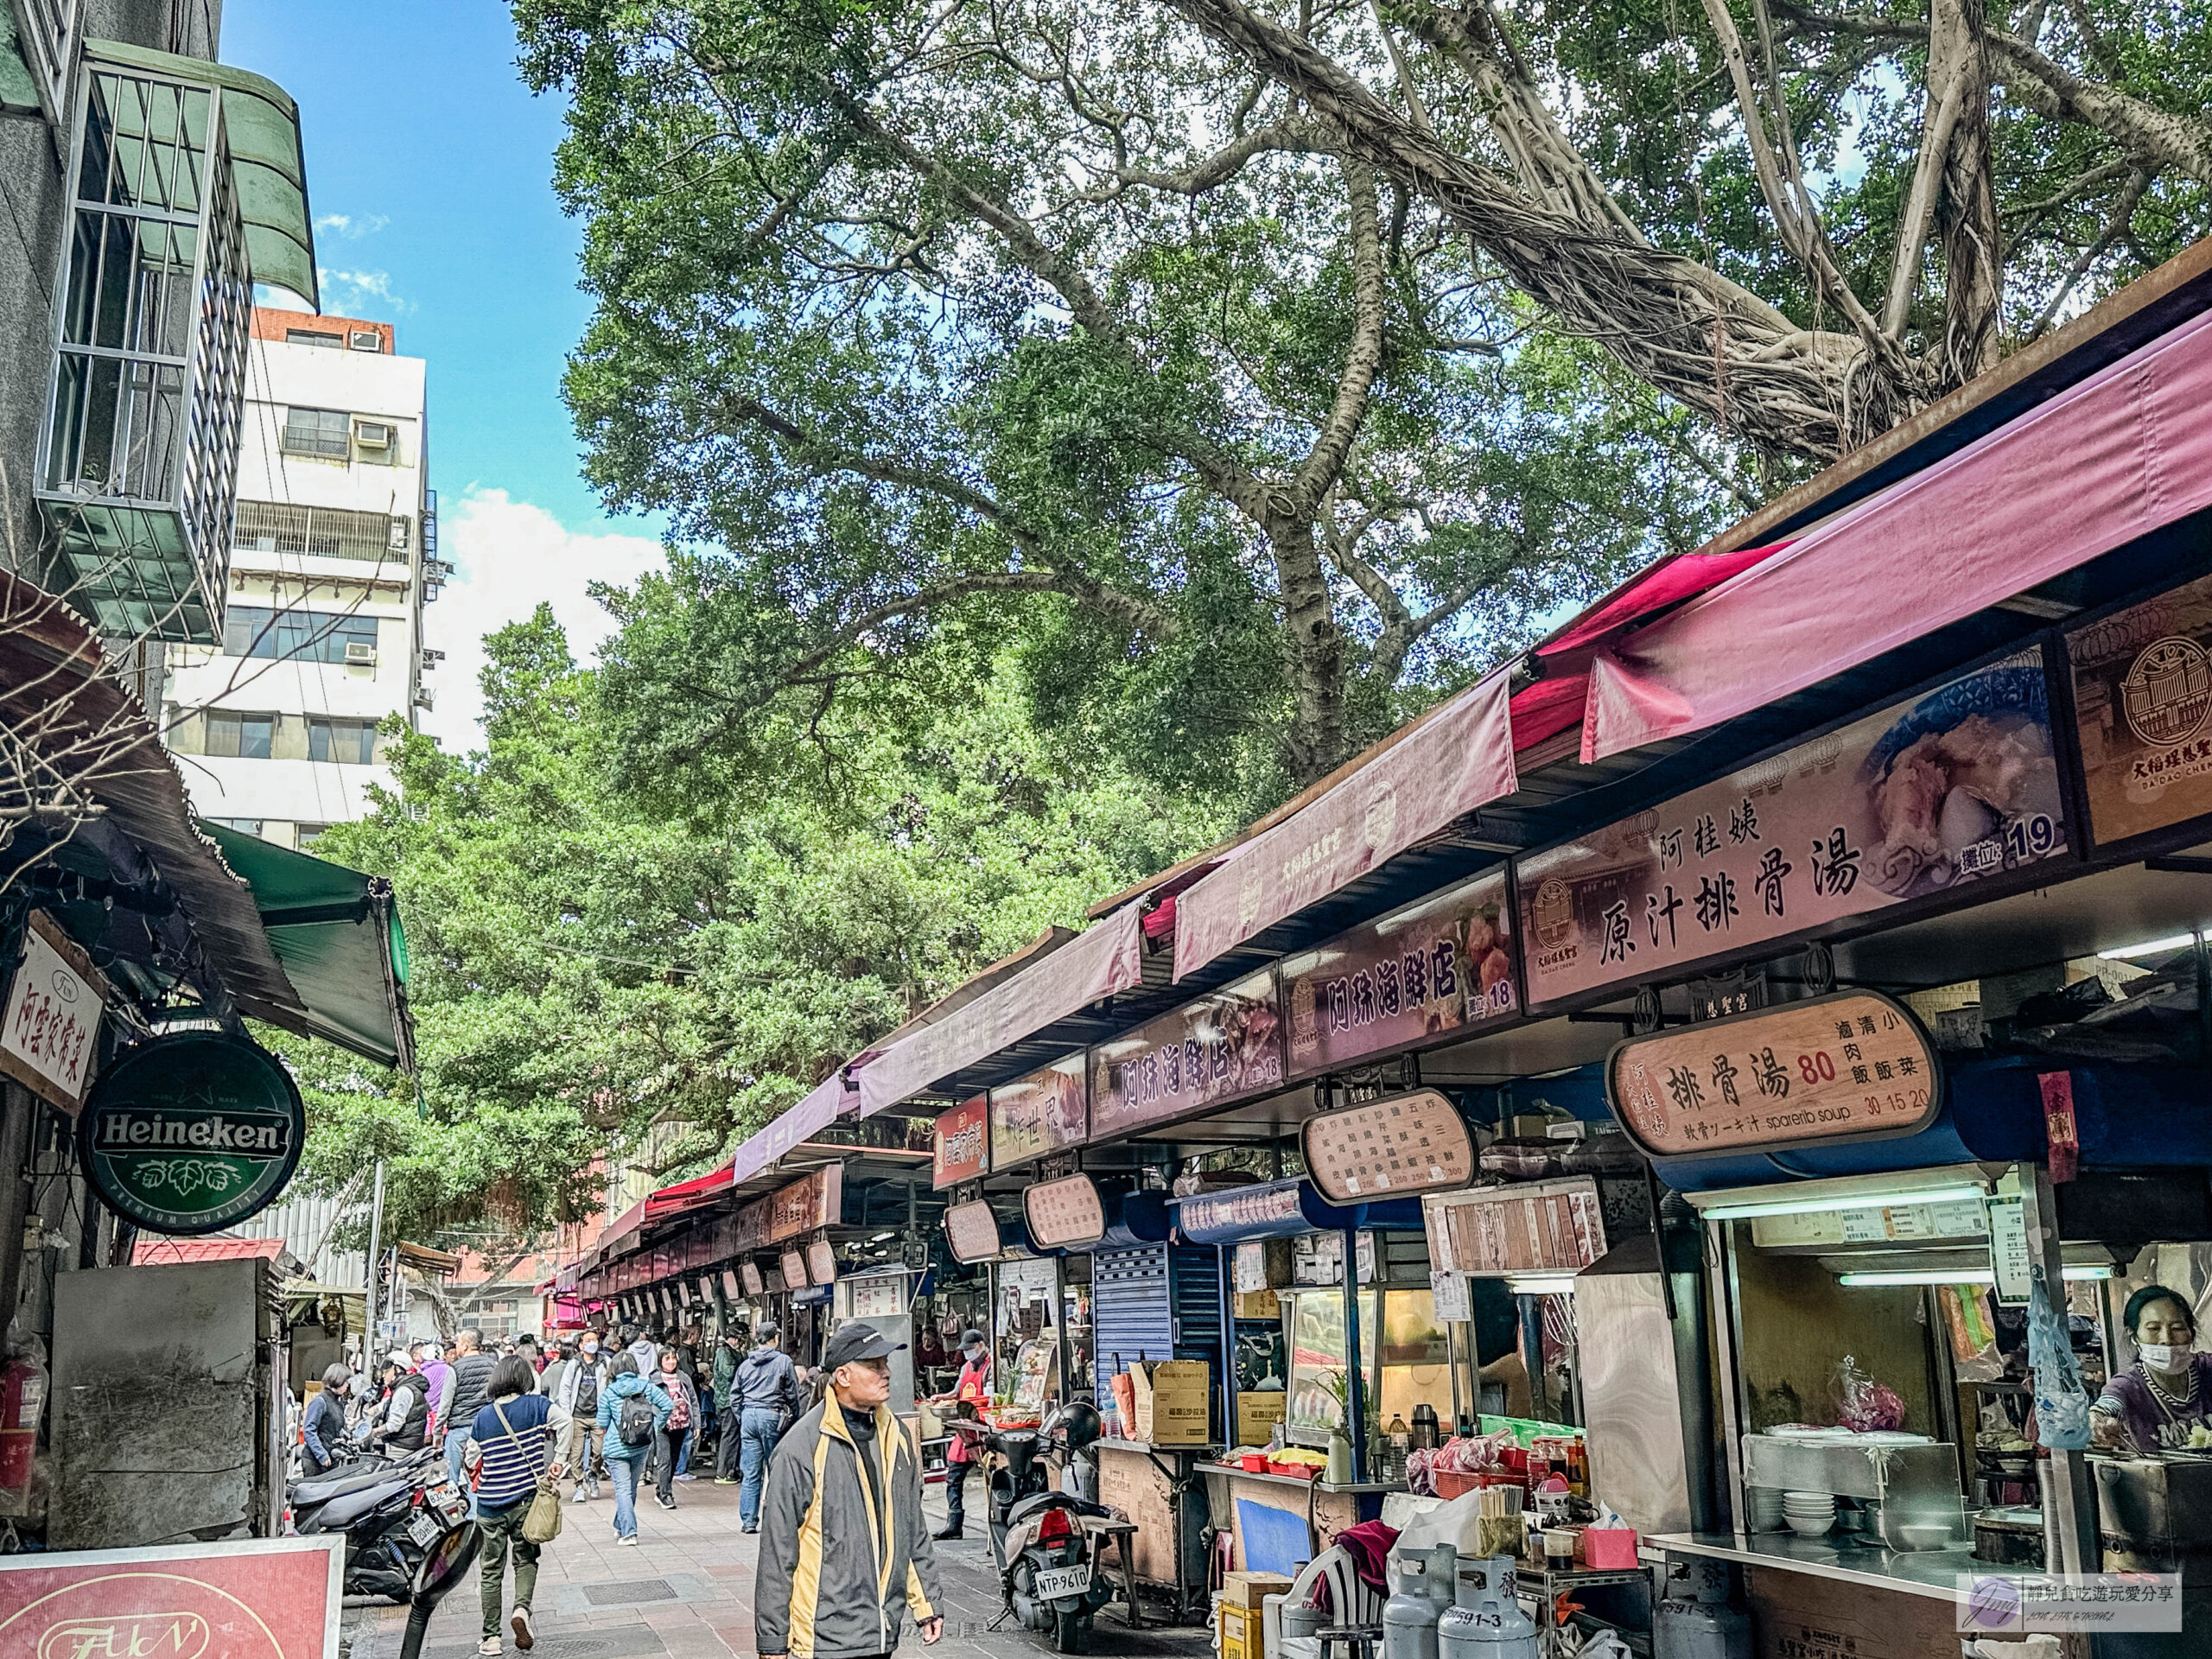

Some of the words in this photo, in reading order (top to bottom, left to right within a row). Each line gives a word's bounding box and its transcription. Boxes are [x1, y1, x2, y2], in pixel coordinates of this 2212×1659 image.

[1659, 799, 1759, 870] 阿桂姨
[2009, 817, 2054, 857] 19
[1599, 827, 1863, 967] 原汁排骨湯
[1327, 939, 1457, 1036] 阿珠海鮮店
[1489, 982, 1510, 1009] 18
[1122, 1026, 1229, 1112] 阿珠海鮮店
[1265, 1058, 1278, 1078] 18
[1797, 1051, 1836, 1085] 80
[1834, 1020, 1872, 1084] 滷肉飯
[1666, 1046, 1791, 1112] 排骨湯
[1865, 1096, 1881, 1115] 30
[1887, 1092, 1906, 1111] 15
[1909, 1089, 1929, 1108] 20
[103, 1114, 278, 1149] Heineken
[1011, 1095, 1058, 1154] 炸世界
[1766, 1109, 1815, 1130] sparerib
[1817, 1106, 1851, 1122] soup
[1447, 1166, 1463, 1176] 300
[110, 1184, 177, 1224] PREMIUM
[191, 1188, 261, 1224] QUALITY
